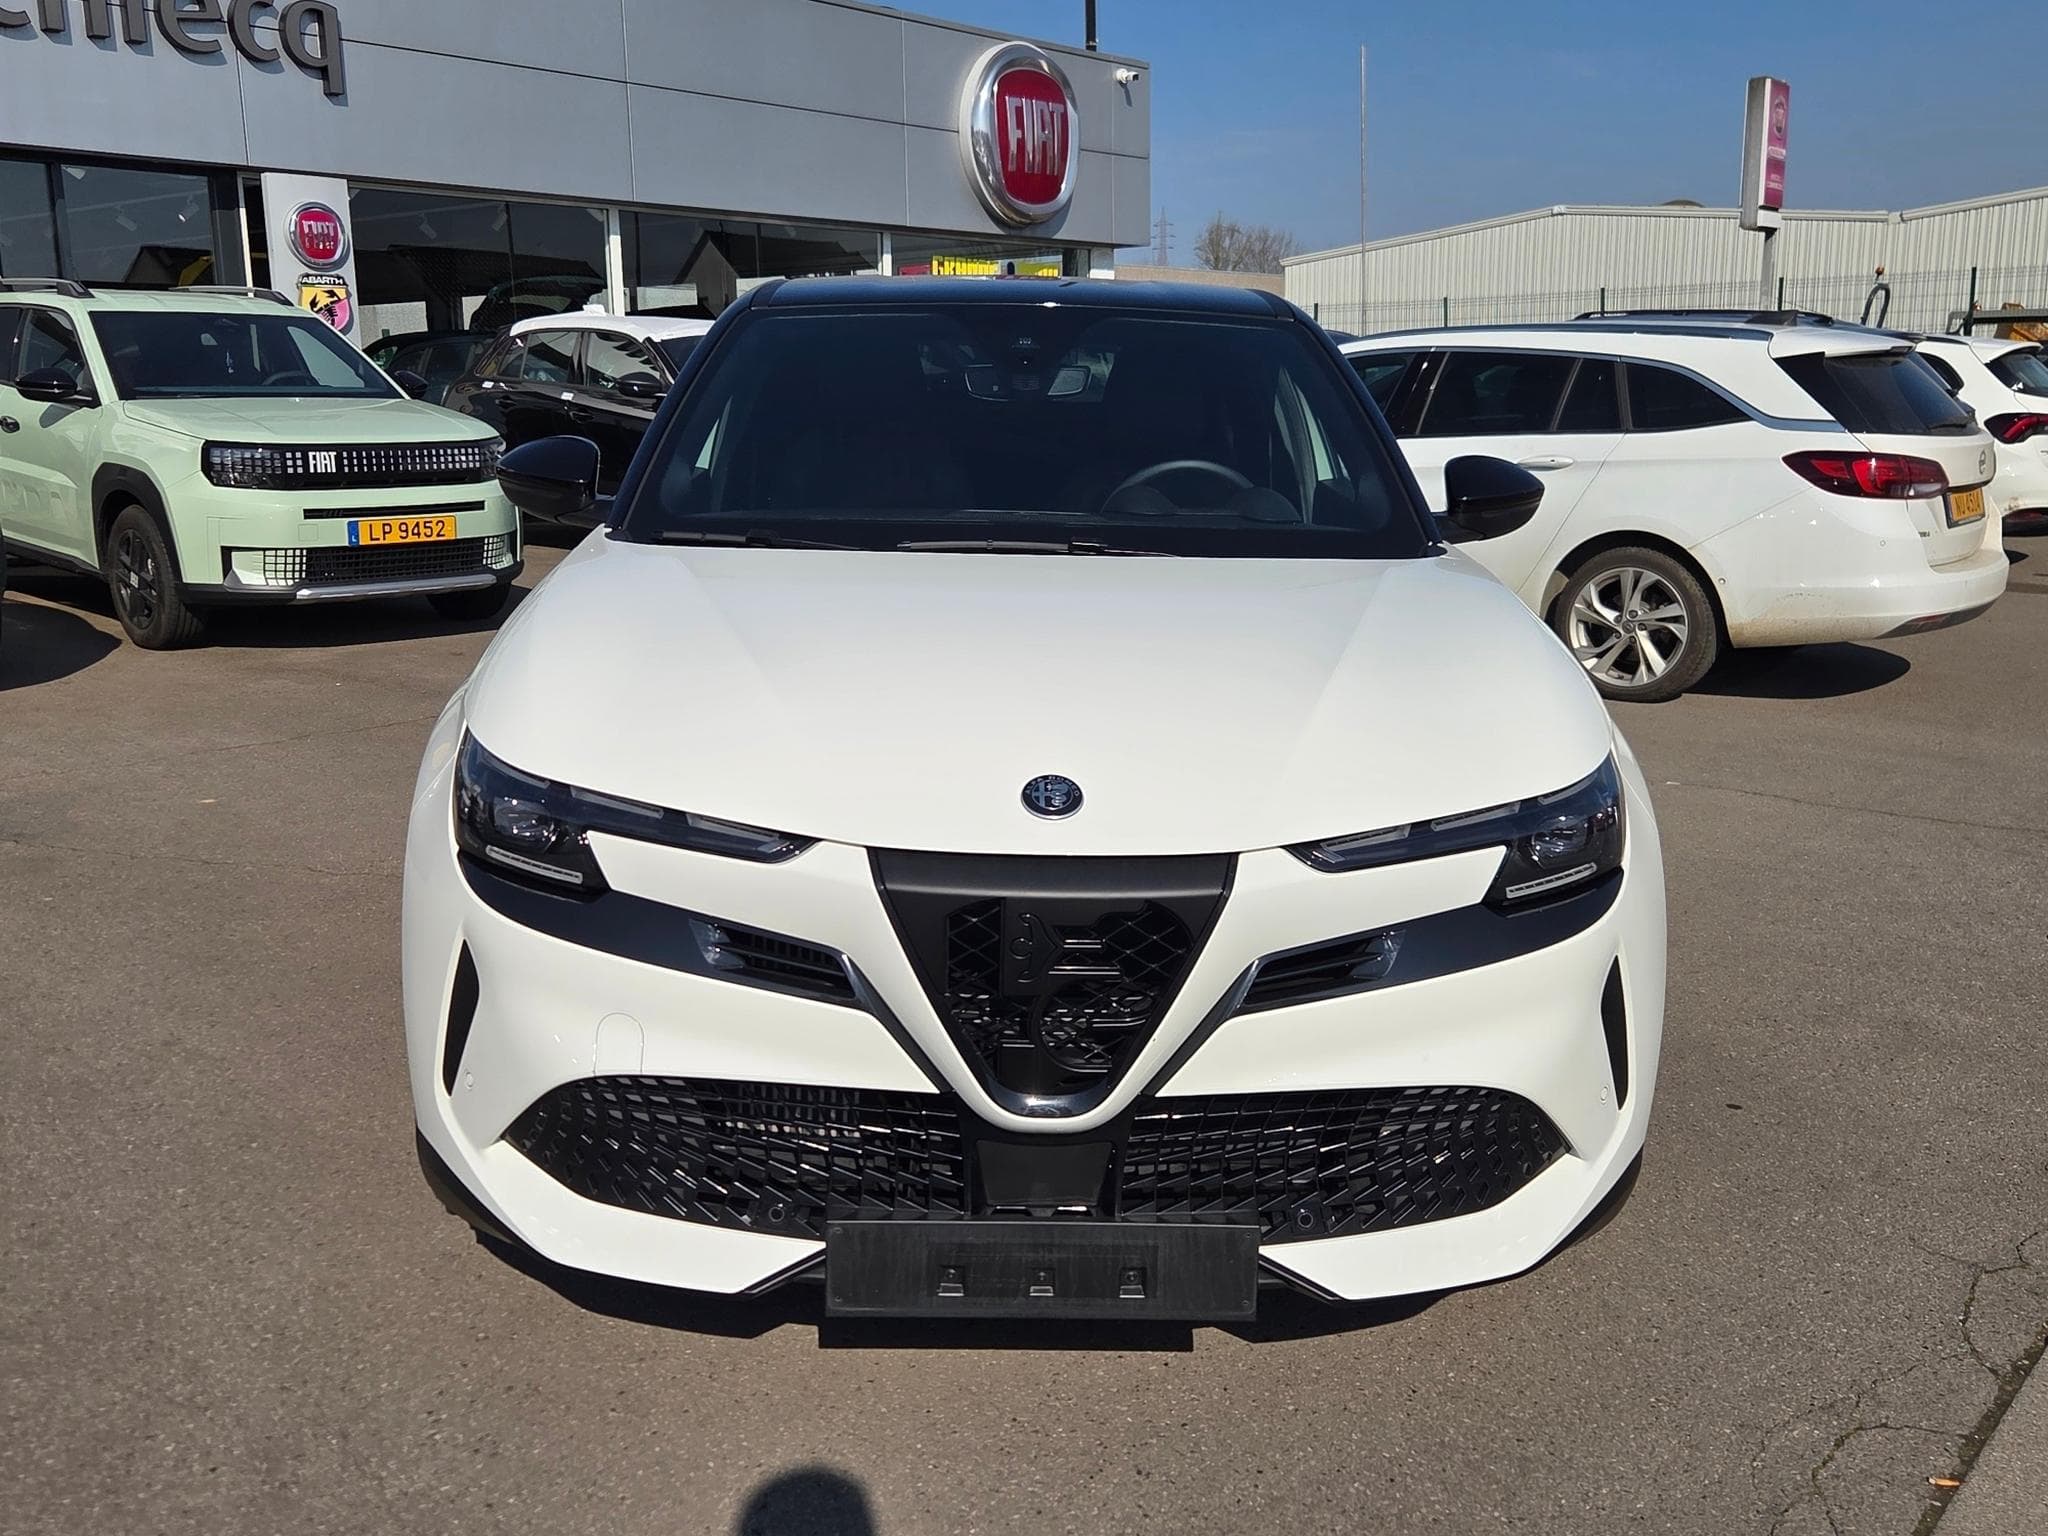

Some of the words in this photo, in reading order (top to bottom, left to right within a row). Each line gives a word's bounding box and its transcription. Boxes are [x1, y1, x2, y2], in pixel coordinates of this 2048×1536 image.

[1005, 95, 1065, 176] FIAT
[301, 275, 344, 286] ABARTH
[308, 451, 337, 473] FIAT
[369, 522, 392, 541] LP
[398, 520, 446, 540] 9452
